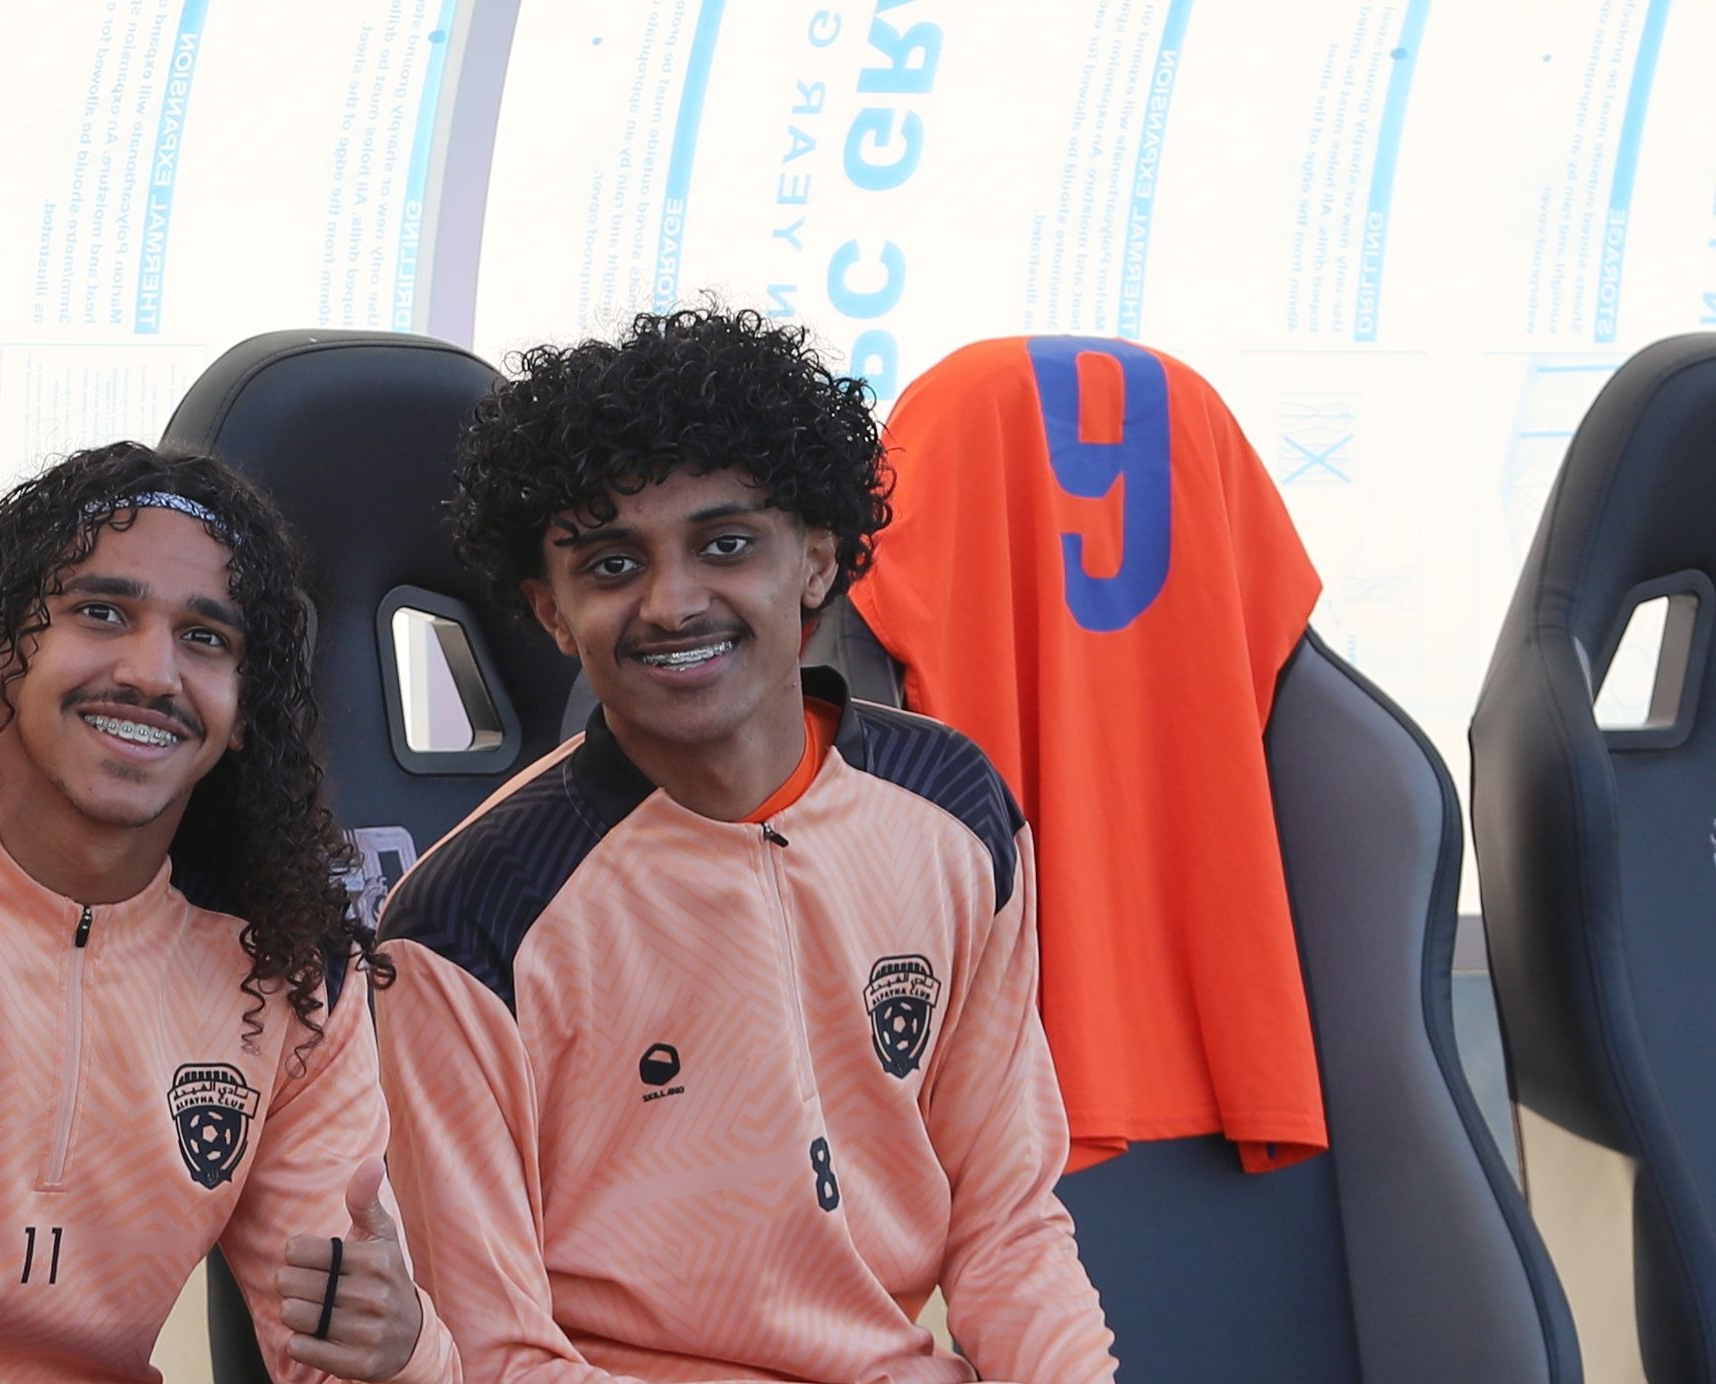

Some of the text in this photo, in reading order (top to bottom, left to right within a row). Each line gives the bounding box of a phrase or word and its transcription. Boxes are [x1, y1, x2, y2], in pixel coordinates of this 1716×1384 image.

[1025, 334, 1172, 634] 9
[809, 1135, 840, 1212] 8
[20, 1226, 63, 1285] 11
